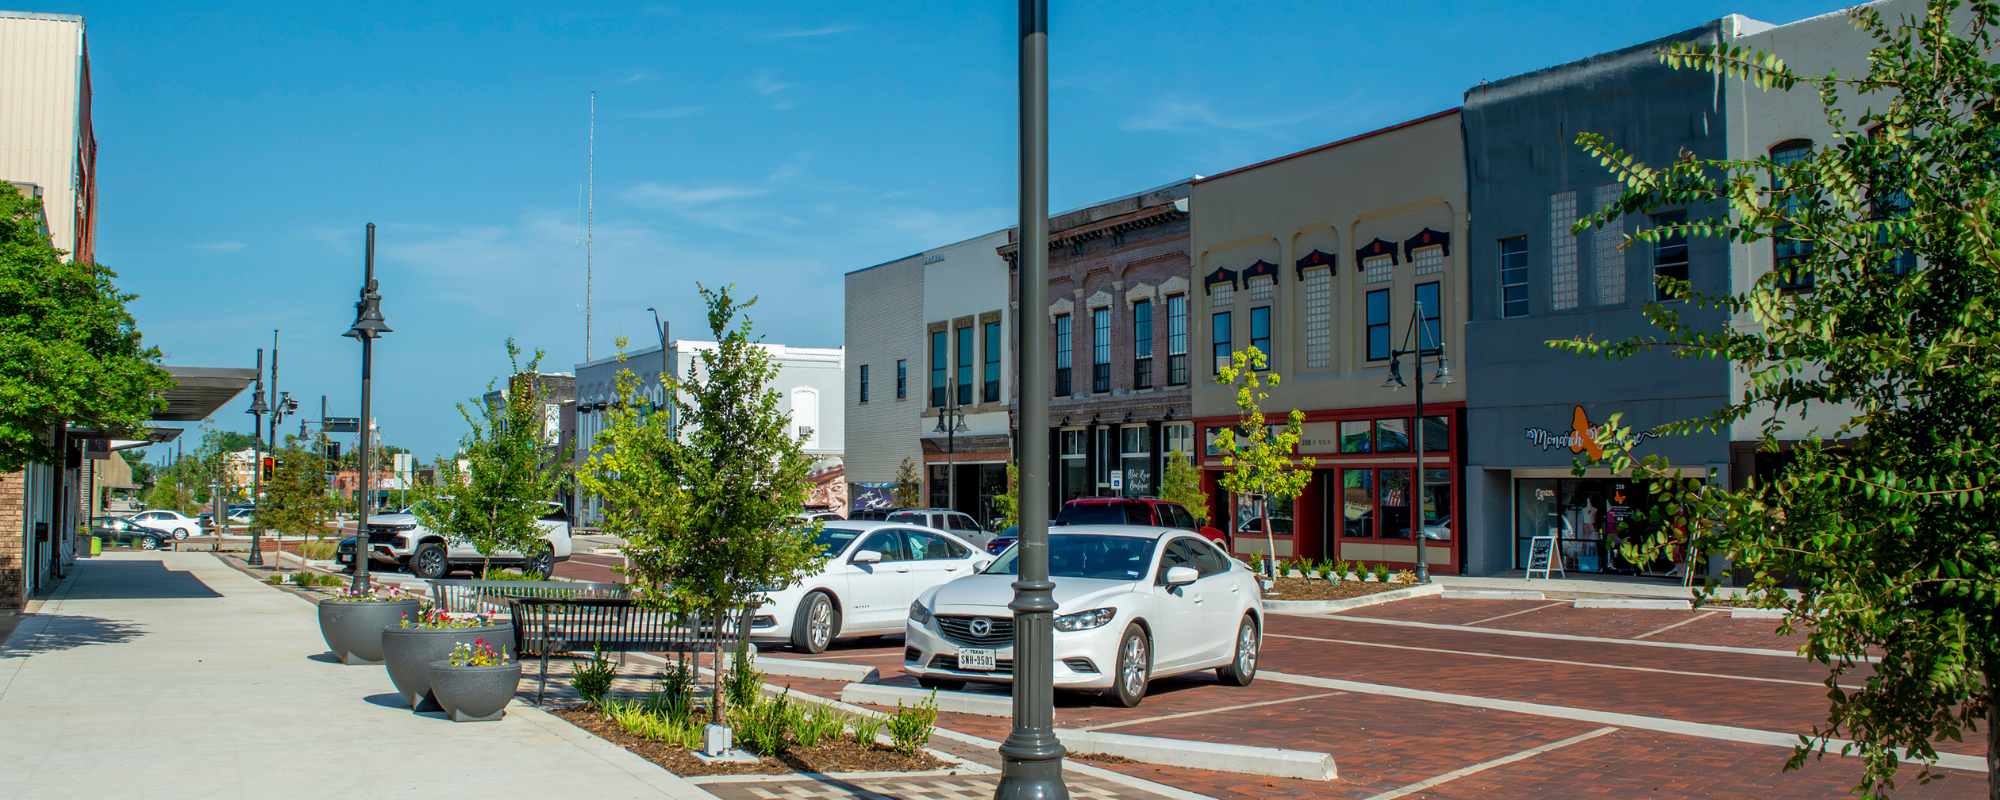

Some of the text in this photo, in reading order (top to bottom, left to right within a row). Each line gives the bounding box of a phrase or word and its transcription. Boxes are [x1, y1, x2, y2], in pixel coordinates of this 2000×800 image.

[1524, 428, 1584, 450] Monarch
[1128, 469, 1138, 479] Blue
[1130, 480, 1148, 491] Boutique
[1535, 488, 1555, 500] Open
[960, 655, 993, 666] SNH-3501
